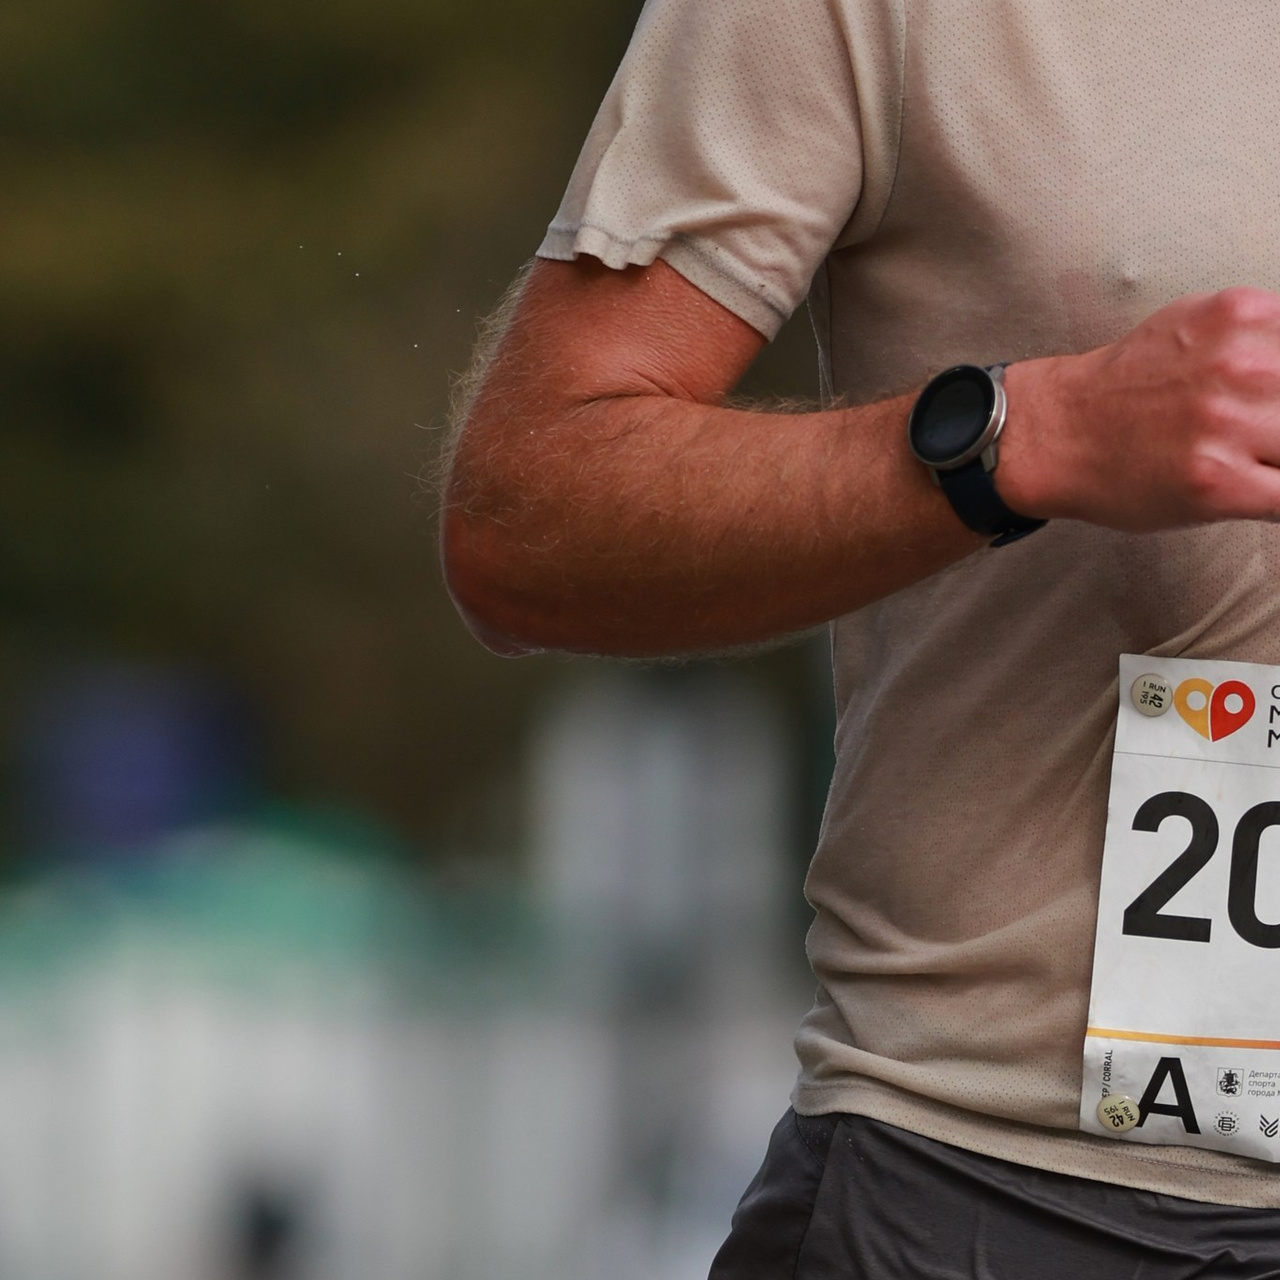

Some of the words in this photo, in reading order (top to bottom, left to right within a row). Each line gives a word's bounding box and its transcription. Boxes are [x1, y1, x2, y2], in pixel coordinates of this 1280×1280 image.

[1149, 682, 1166, 693] RUN
[1140, 690, 1149, 704] 195
[1149, 693, 1163, 708] 42
[1103, 1049, 1113, 1082] CORRAL
[1248, 1080, 1276, 1088] спорта
[1247, 1089, 1275, 1097] города
[1104, 1105, 1119, 1116] 195
[1122, 1106, 1136, 1122] RUN
[1109, 1114, 1124, 1127] 42
